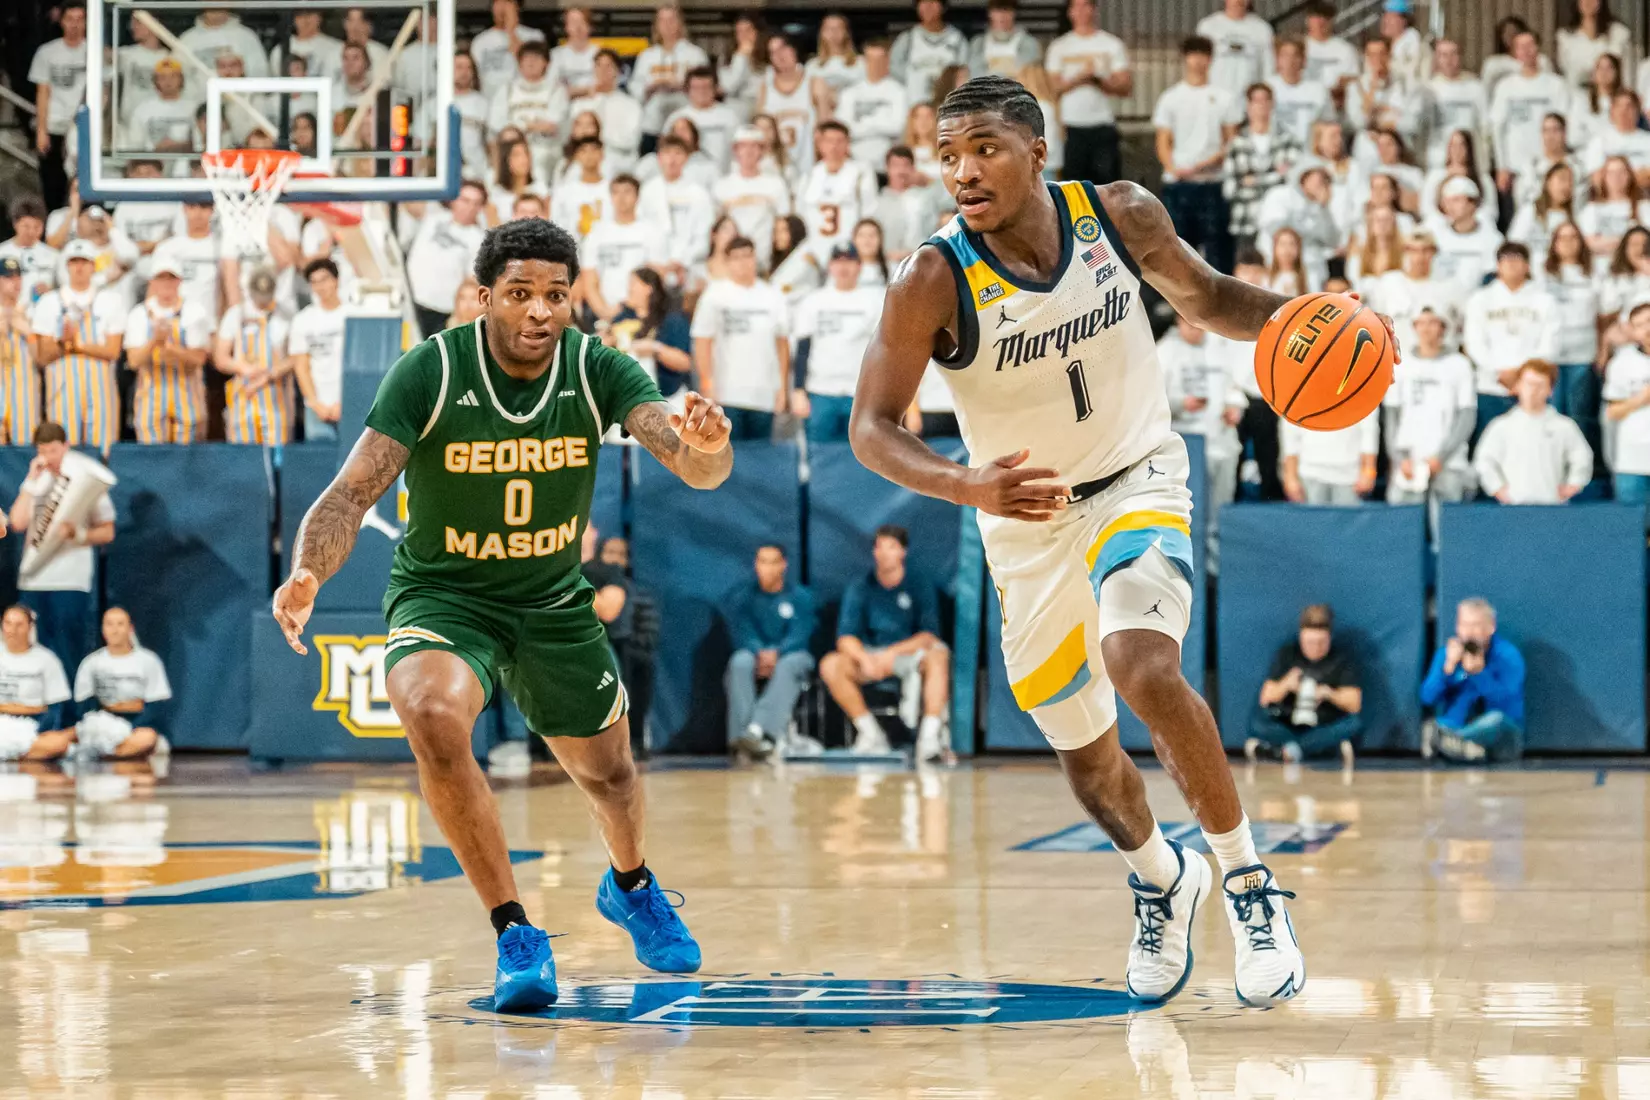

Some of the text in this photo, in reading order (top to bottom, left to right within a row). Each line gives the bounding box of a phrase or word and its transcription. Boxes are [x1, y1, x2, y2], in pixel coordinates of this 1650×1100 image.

[819, 204, 841, 236] 3
[988, 283, 1001, 293] THE
[1096, 262, 1111, 277] BIG
[1096, 265, 1117, 284] EAST
[980, 288, 1004, 304] CHANGE
[993, 286, 1131, 371] Marquette
[1288, 303, 1343, 365] ELITE
[1066, 360, 1093, 422] 1
[445, 436, 588, 473] GEORGE
[504, 479, 533, 526] 0
[445, 515, 577, 560] MASON
